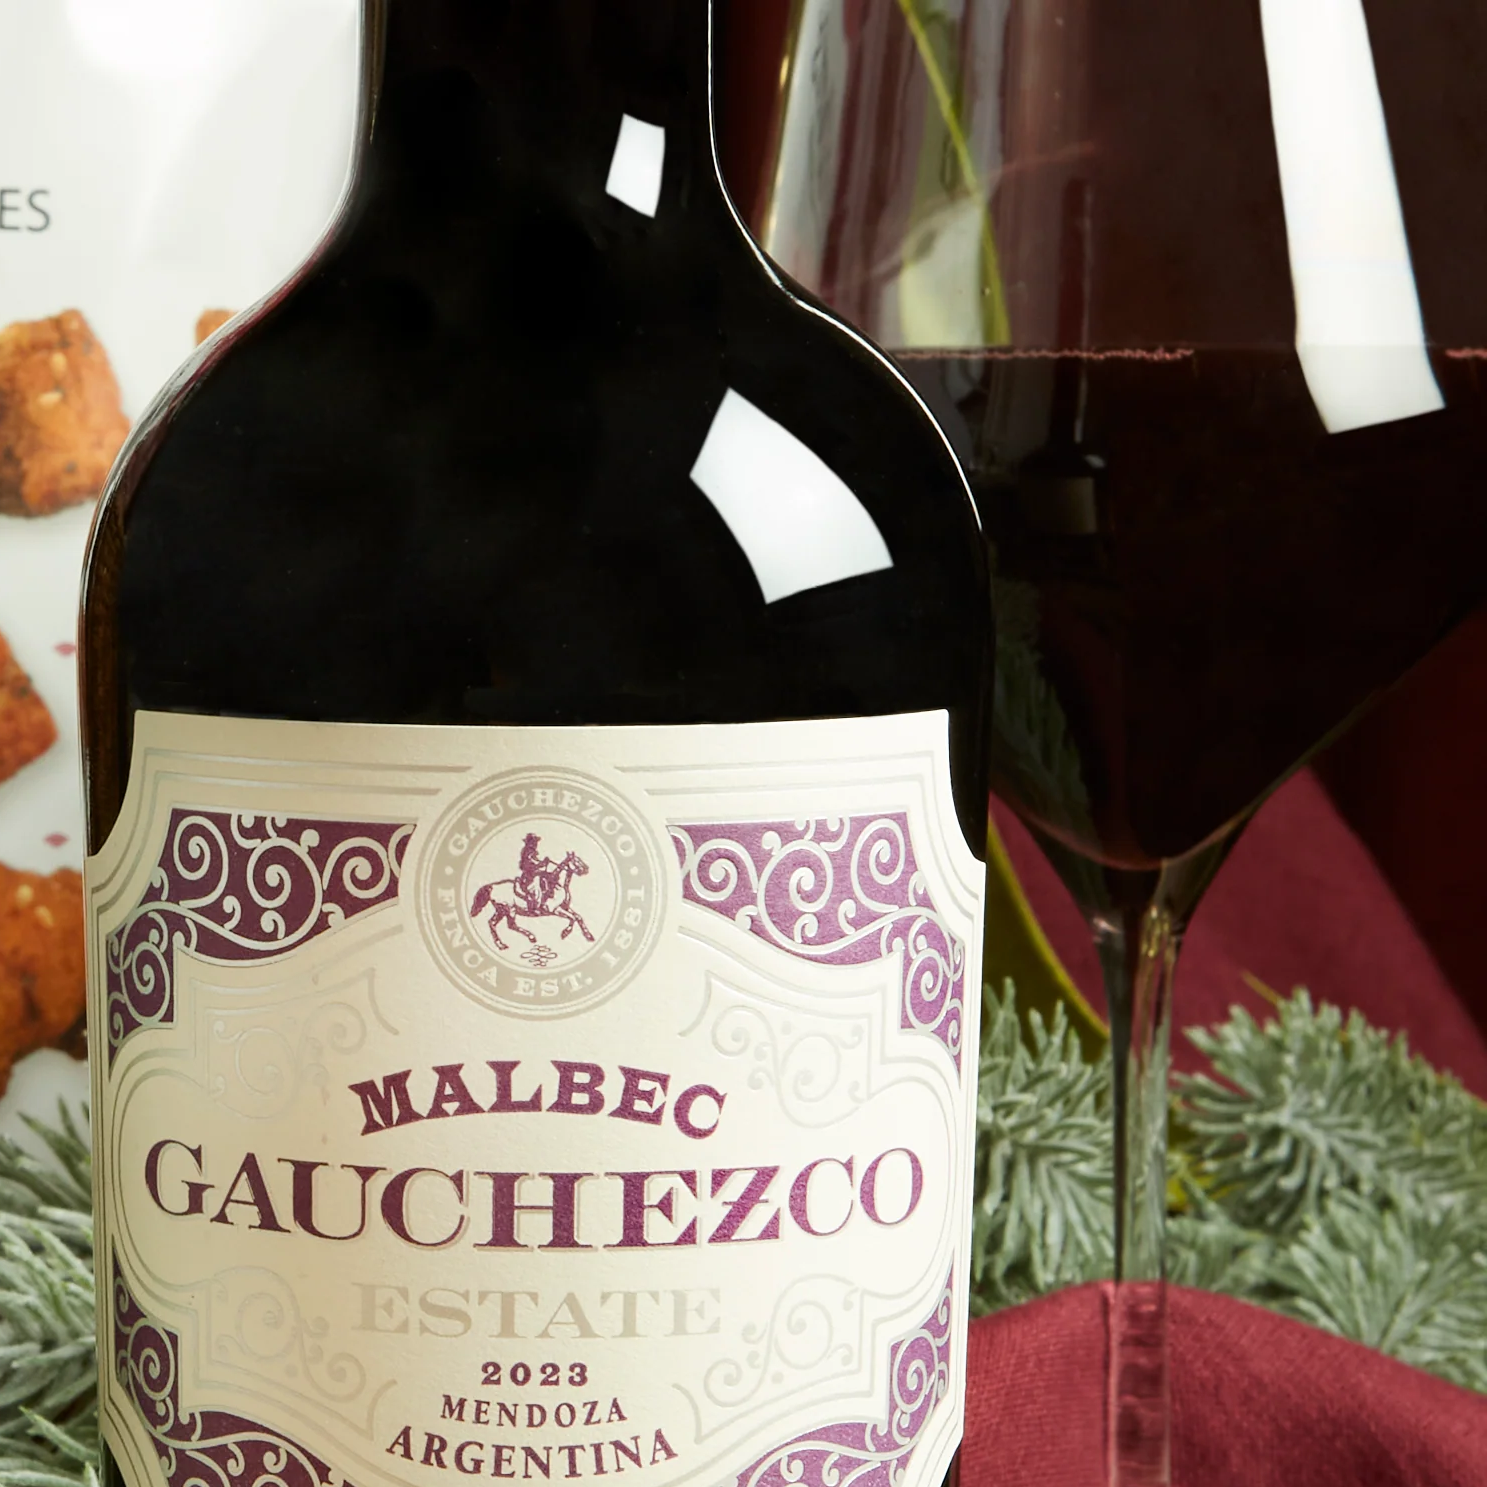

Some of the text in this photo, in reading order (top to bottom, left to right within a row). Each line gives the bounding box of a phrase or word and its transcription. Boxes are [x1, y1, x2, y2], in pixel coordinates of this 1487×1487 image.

[448, 787, 637, 859] GAUCHEZCO
[436, 885, 645, 998] FINCA EST. 1881
[348, 1060, 728, 1141] MALBEC
[351, 1282, 722, 1340] ESTATE
[481, 1360, 589, 1388] 2023
[439, 1394, 629, 1429] MENDOZA
[385, 1424, 680, 1480] ARGENTINA
